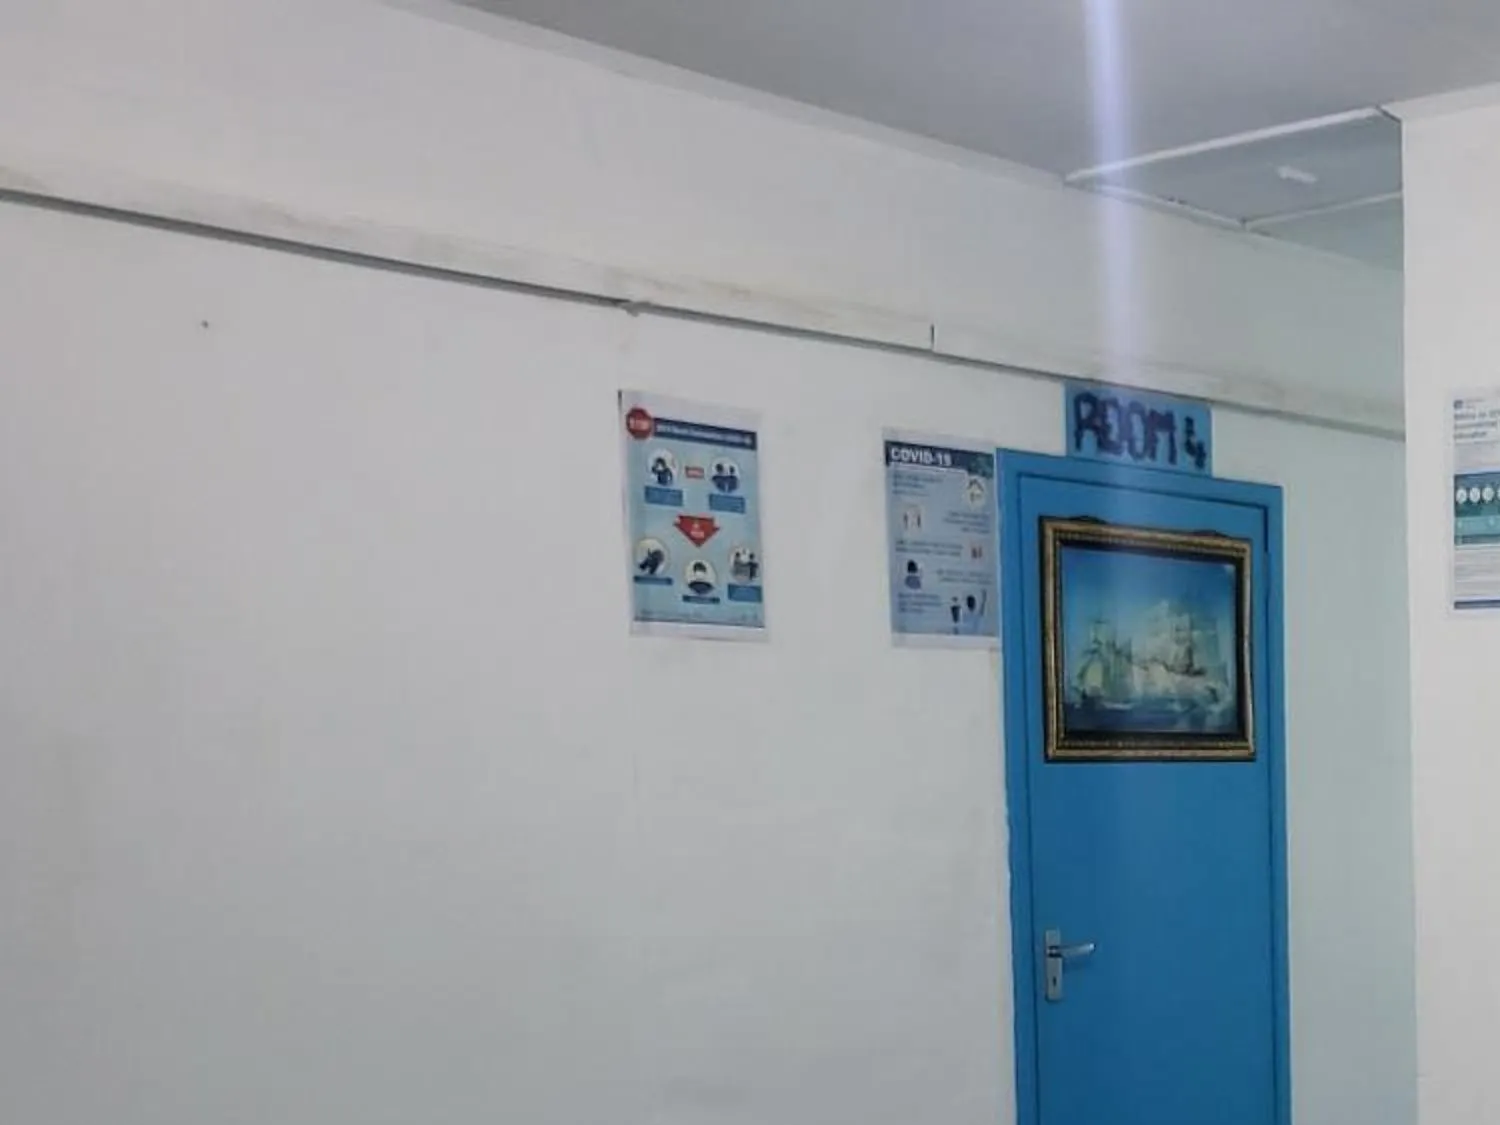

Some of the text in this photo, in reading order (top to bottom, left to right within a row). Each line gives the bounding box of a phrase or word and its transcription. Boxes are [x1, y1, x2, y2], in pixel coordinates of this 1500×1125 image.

[1073, 391, 1207, 471] ROOM 4
[890, 447, 953, 467] COVID-19
